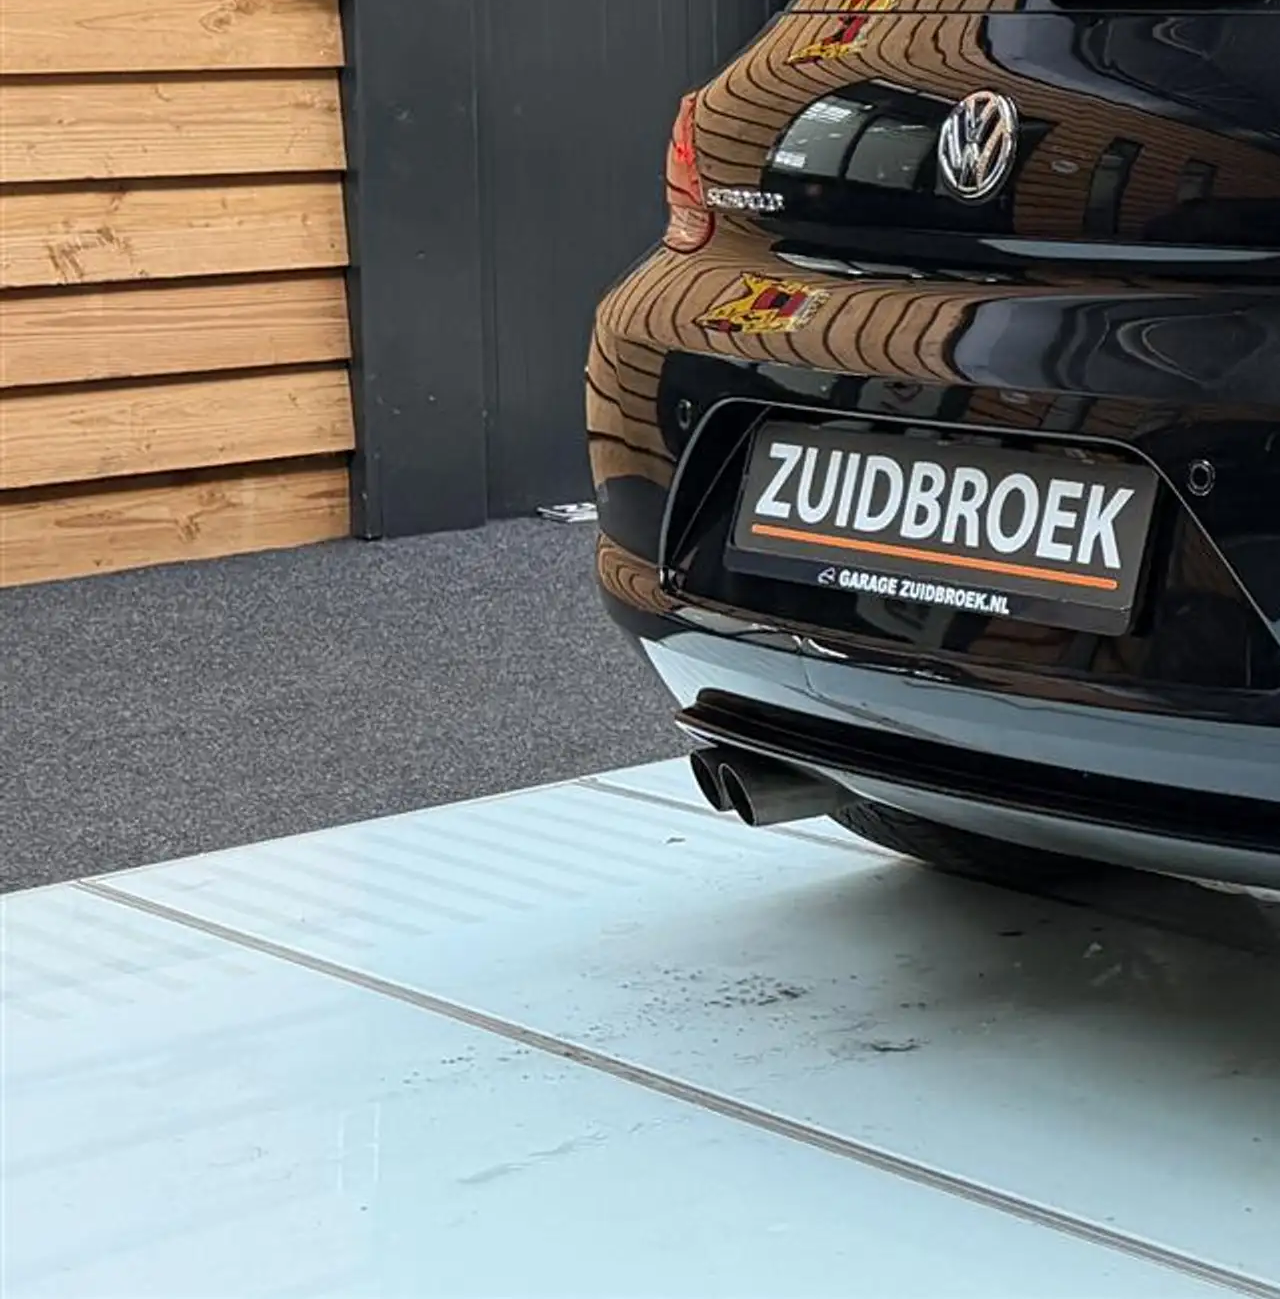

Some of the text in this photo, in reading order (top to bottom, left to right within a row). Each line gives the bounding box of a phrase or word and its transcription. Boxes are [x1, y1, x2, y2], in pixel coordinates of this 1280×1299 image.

[754, 441, 1136, 570] ZUIDBROEK
[838, 568, 1010, 615] GARAGE ZUIDBROEK.NL
